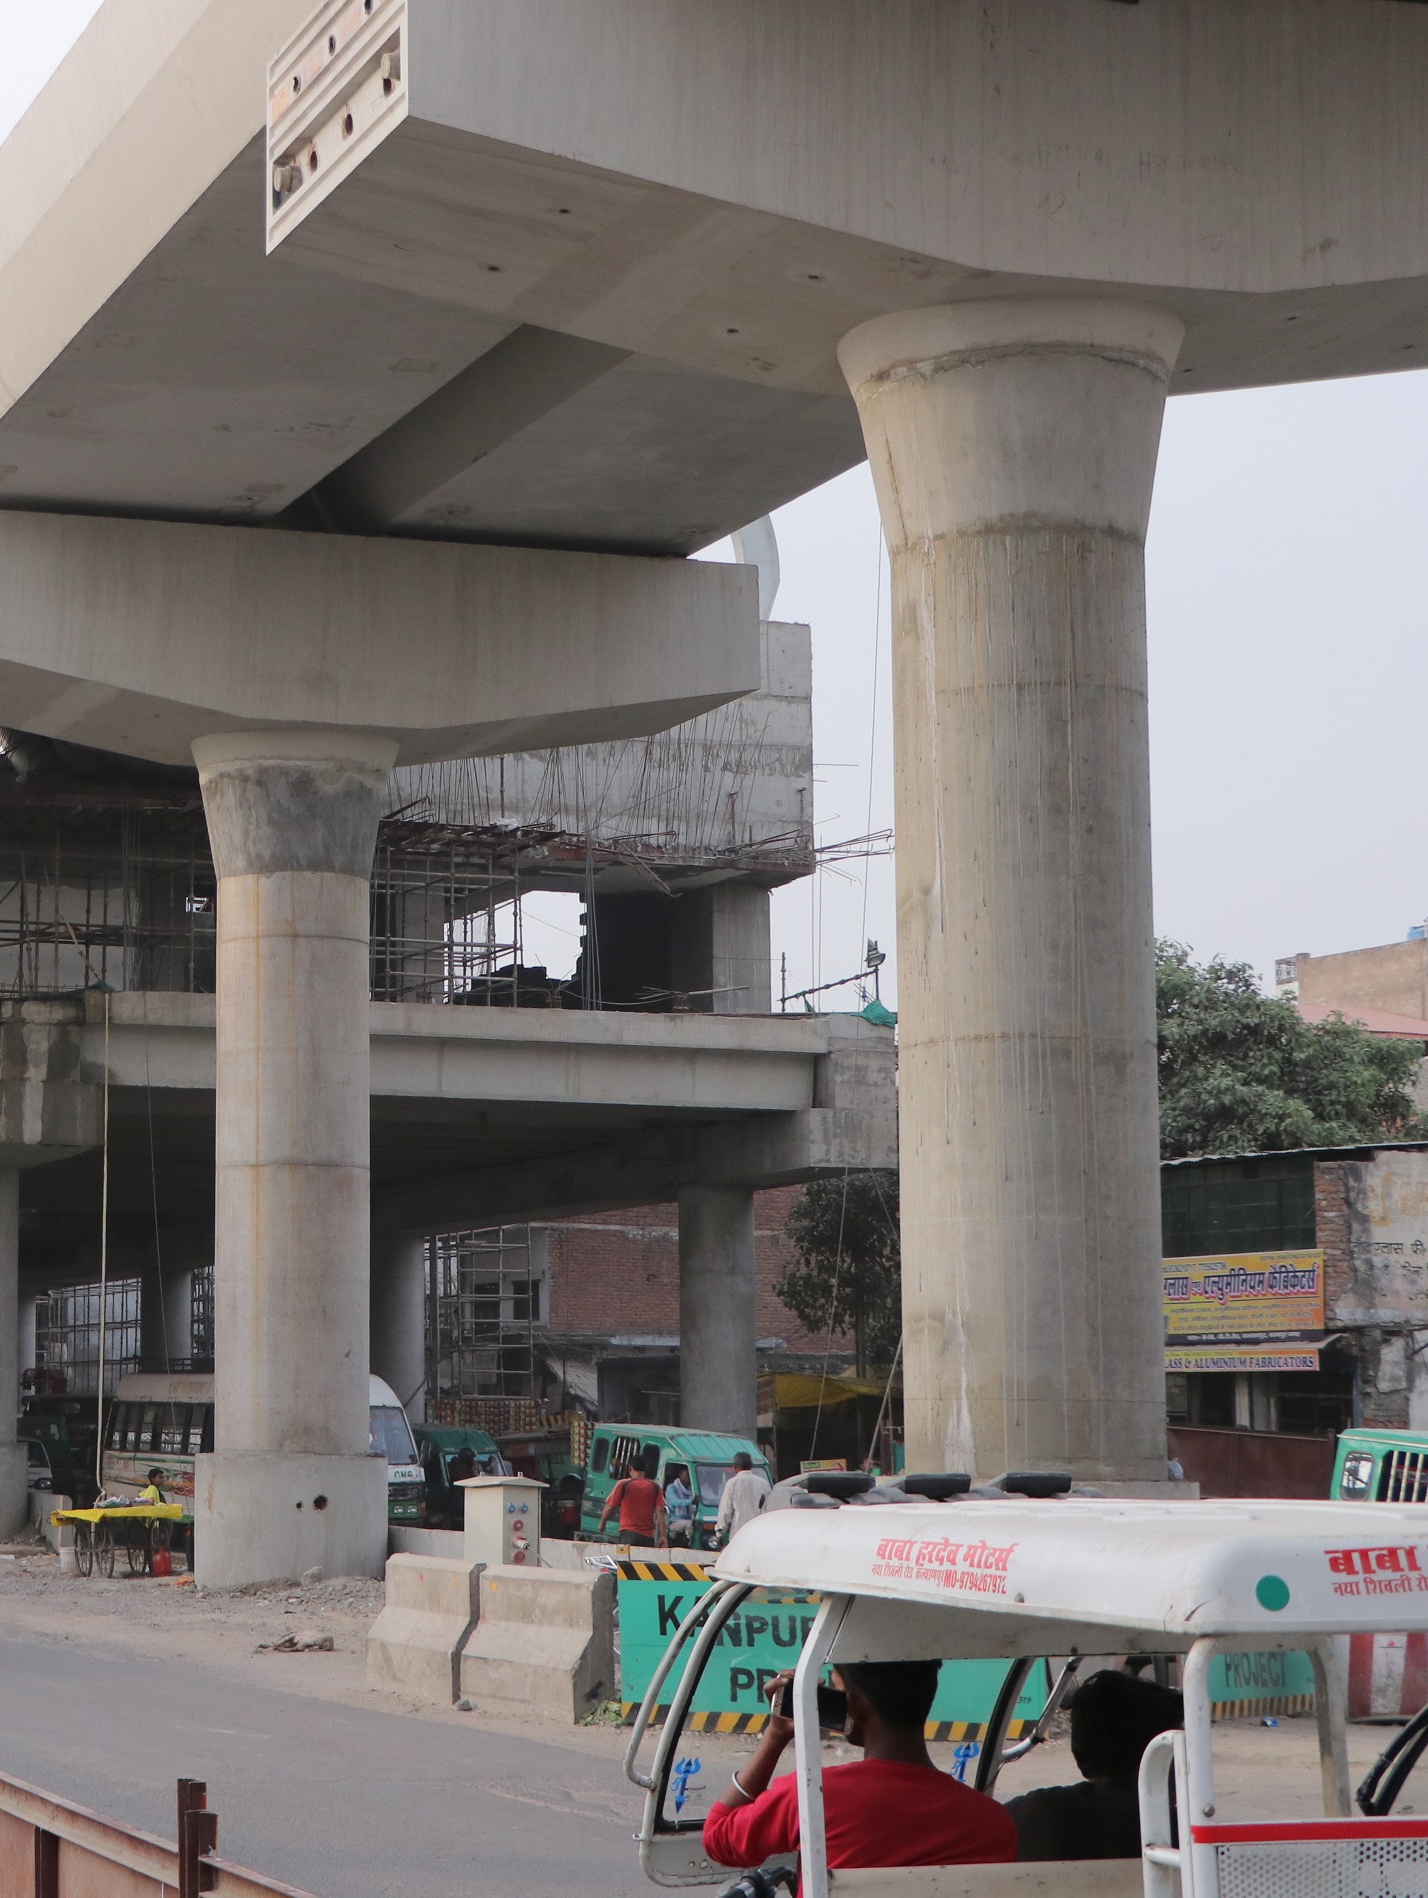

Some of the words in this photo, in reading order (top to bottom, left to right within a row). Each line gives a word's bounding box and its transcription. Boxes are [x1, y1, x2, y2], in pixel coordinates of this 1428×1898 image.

[1193, 1356, 1247, 1369] ALUMINIUM
[1249, 1356, 1314, 1368] FABRICATORS
[876, 1538, 918, 1562] बाबा
[915, 1537, 965, 1568] हरदेव
[963, 1540, 1020, 1572] मोटर्स
[1324, 1546, 1422, 1575] बाबा
[1332, 1581, 1361, 1596] नया
[1225, 1650, 1286, 1688] PROJECT
